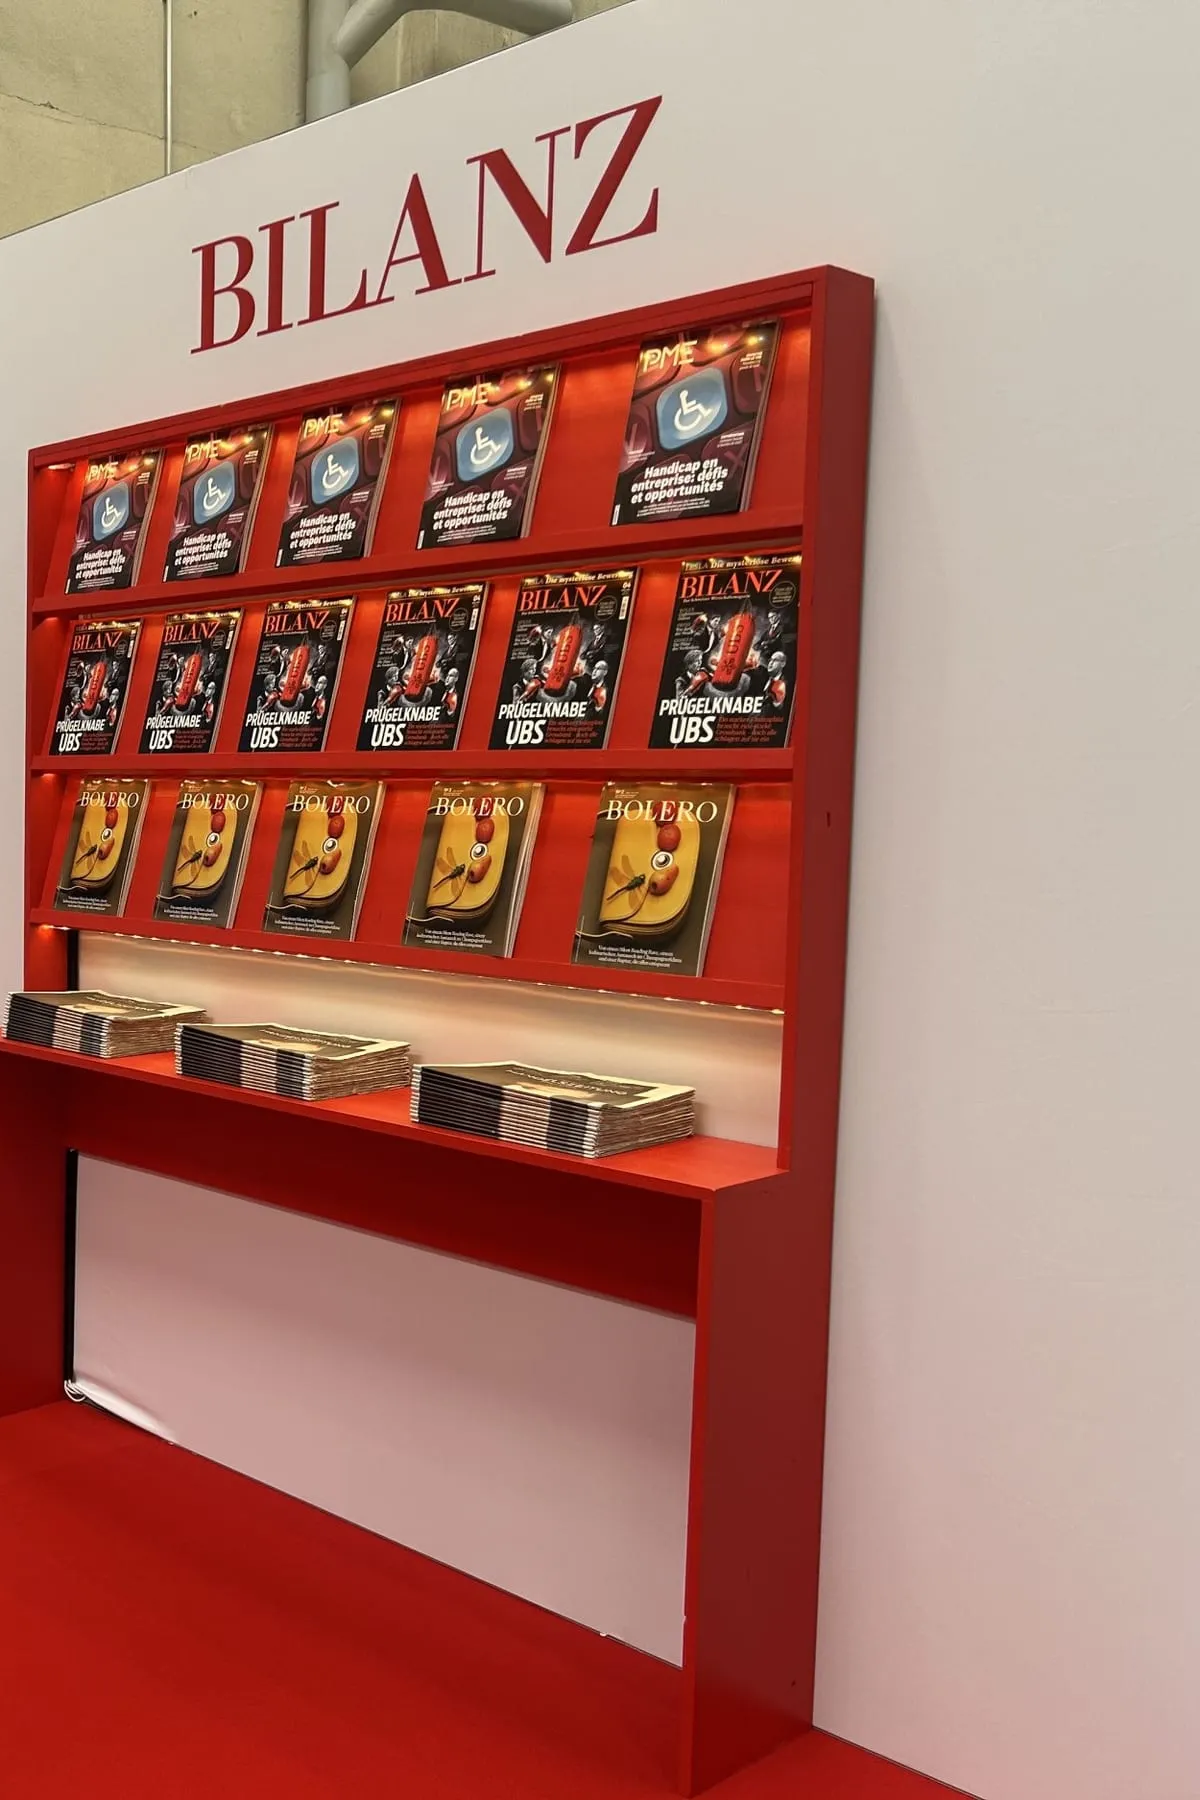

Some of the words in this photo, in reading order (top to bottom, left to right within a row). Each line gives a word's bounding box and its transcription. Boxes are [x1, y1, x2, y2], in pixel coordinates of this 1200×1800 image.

[191, 95, 663, 354] BILANZ
[643, 340, 697, 372] PME
[446, 383, 492, 411] PME
[644, 460, 700, 478] Handicap
[702, 458, 719, 469] en
[631, 475, 695, 493] entreprise:
[697, 466, 728, 482] défis
[444, 491, 490, 507] Handicap
[491, 490, 505, 500] en
[631, 490, 643, 504] et
[644, 479, 724, 503] opportunités
[433, 504, 486, 520] entreprise:
[487, 497, 512, 512] défis
[300, 514, 337, 528] Handicap
[339, 512, 350, 522] en
[433, 519, 442, 531] et
[444, 509, 508, 528] opportunités
[290, 539, 298, 549] et
[711, 560, 724, 569] Die
[679, 568, 783, 599] BILANZ
[519, 584, 607, 612] BILANZ
[385, 598, 460, 623] BILANZ
[164, 621, 220, 643] BILANZ
[264, 609, 330, 634] BILANZ
[73, 631, 122, 651] BILANZ
[365, 706, 441, 723] PRÜGELKNABE
[498, 701, 588, 719] PRÜGELKNABE
[659, 695, 763, 716] PRÜGELKNABE
[56, 718, 106, 733] PRÜGELKNABE
[146, 714, 201, 730] PRÜGELKNABE
[246, 710, 312, 727] PRÜGELKNABE
[149, 729, 175, 750] UBS
[250, 726, 281, 749] UBS
[371, 723, 406, 747] UBS
[506, 719, 547, 745] UBS
[670, 716, 716, 743] UBS
[58, 732, 82, 752] UBS
[80, 791, 139, 808] BOLERO
[182, 793, 249, 811] BOLERO
[292, 795, 371, 814] BOLERO
[435, 796, 524, 817] BOLERO
[606, 800, 718, 823] BOLERO
